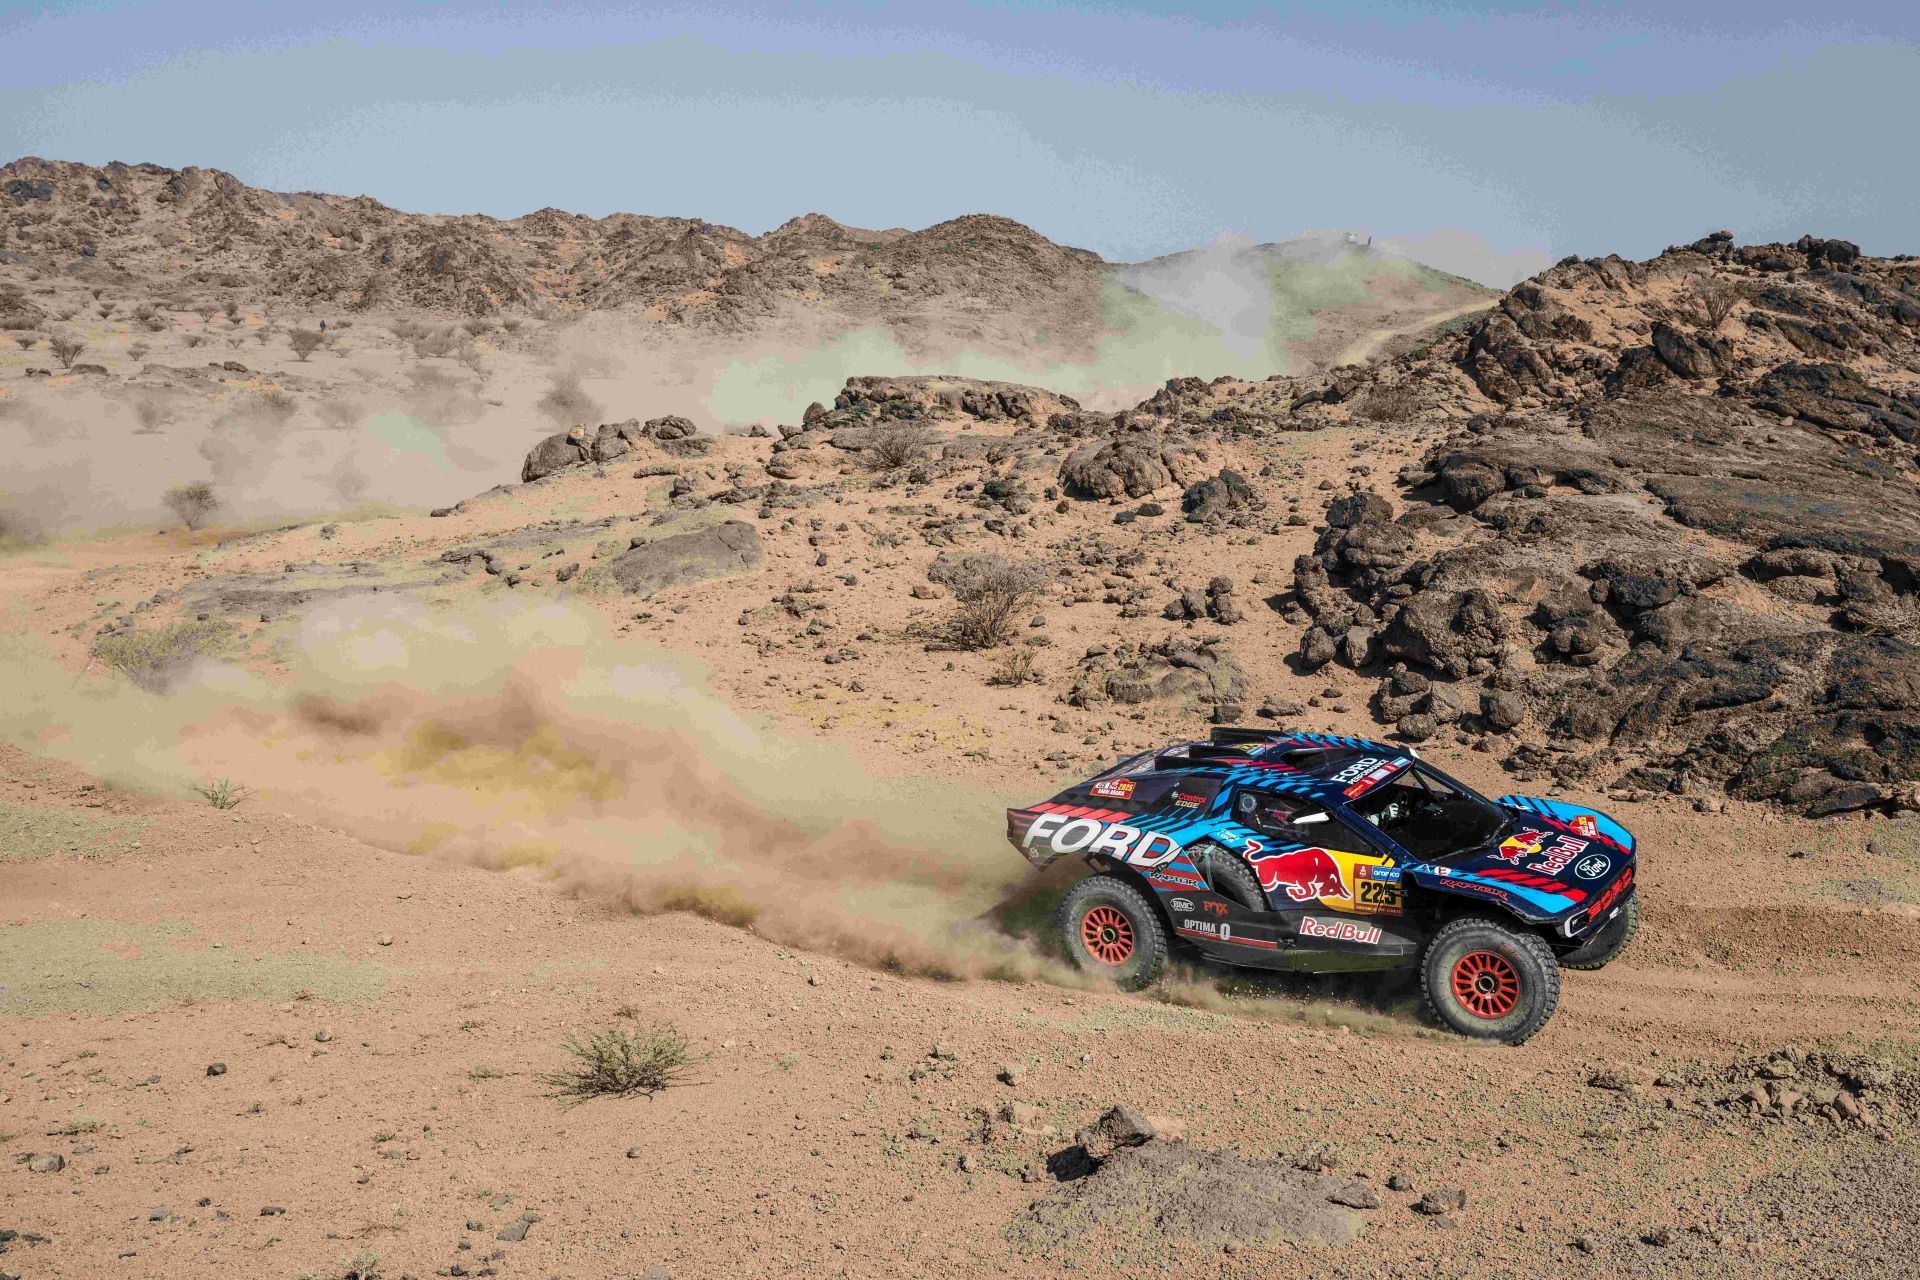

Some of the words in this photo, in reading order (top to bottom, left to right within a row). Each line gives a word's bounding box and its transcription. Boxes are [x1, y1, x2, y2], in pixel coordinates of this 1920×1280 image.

[1330, 757, 1378, 783] FORD
[1175, 800, 1200, 809] EDGE
[1178, 792, 1207, 804] Castrol
[1022, 813, 1182, 868] FORD
[1579, 857, 1607, 877] Ford
[1360, 881, 1397, 905] 225
[1439, 879, 1508, 901] RAPTOR
[1587, 867, 1633, 922] FORD
[1172, 900, 1194, 910] BMC
[1203, 901, 1229, 917] FOX
[1184, 919, 1216, 934] OPTIMA
